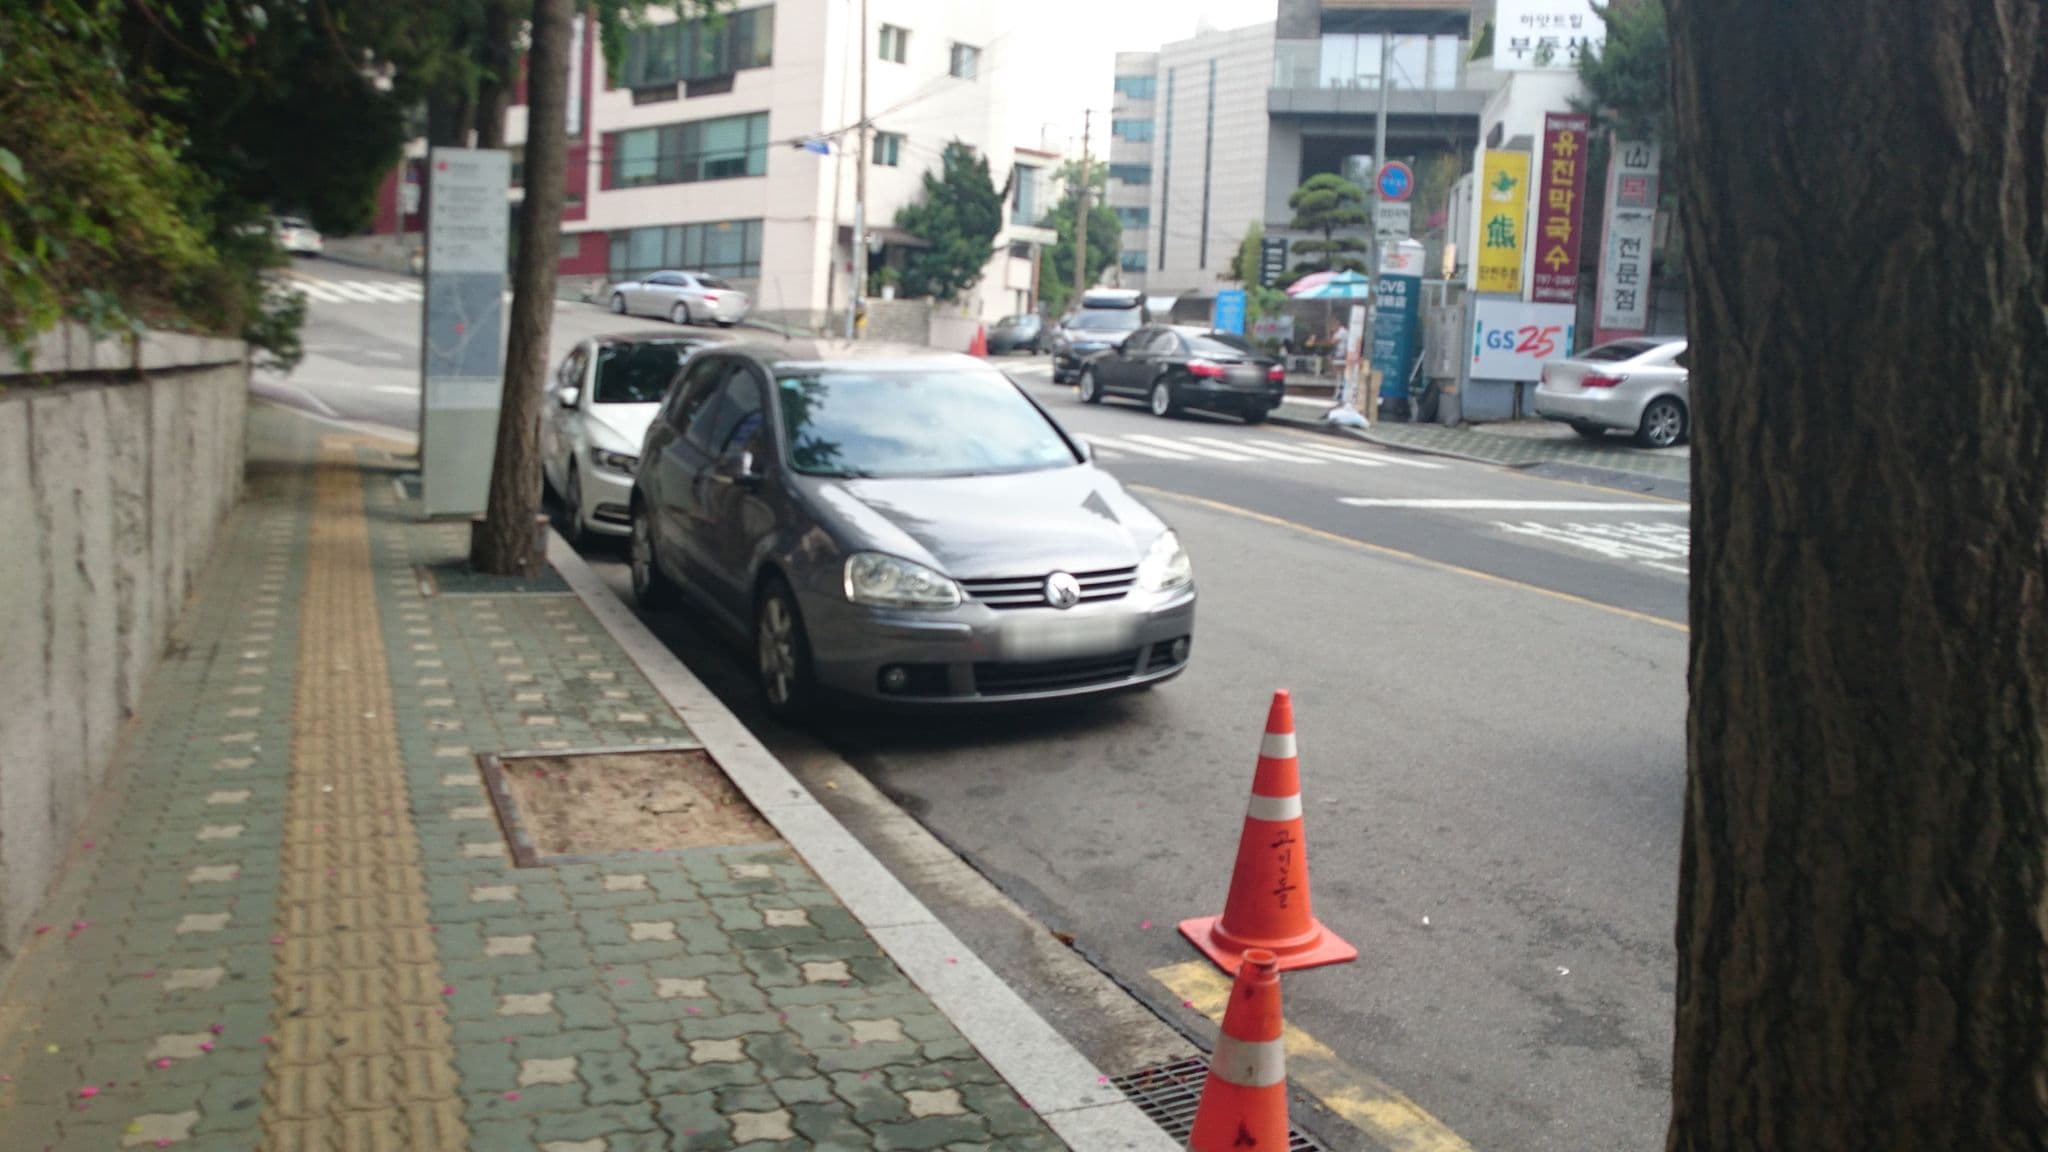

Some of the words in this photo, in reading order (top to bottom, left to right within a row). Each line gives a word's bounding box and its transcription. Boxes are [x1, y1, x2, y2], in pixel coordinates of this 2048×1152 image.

[1543, 130, 1579, 272] 유진막국수
[1615, 236, 1642, 312] 전문점
[1486, 325, 1563, 358] GS25
